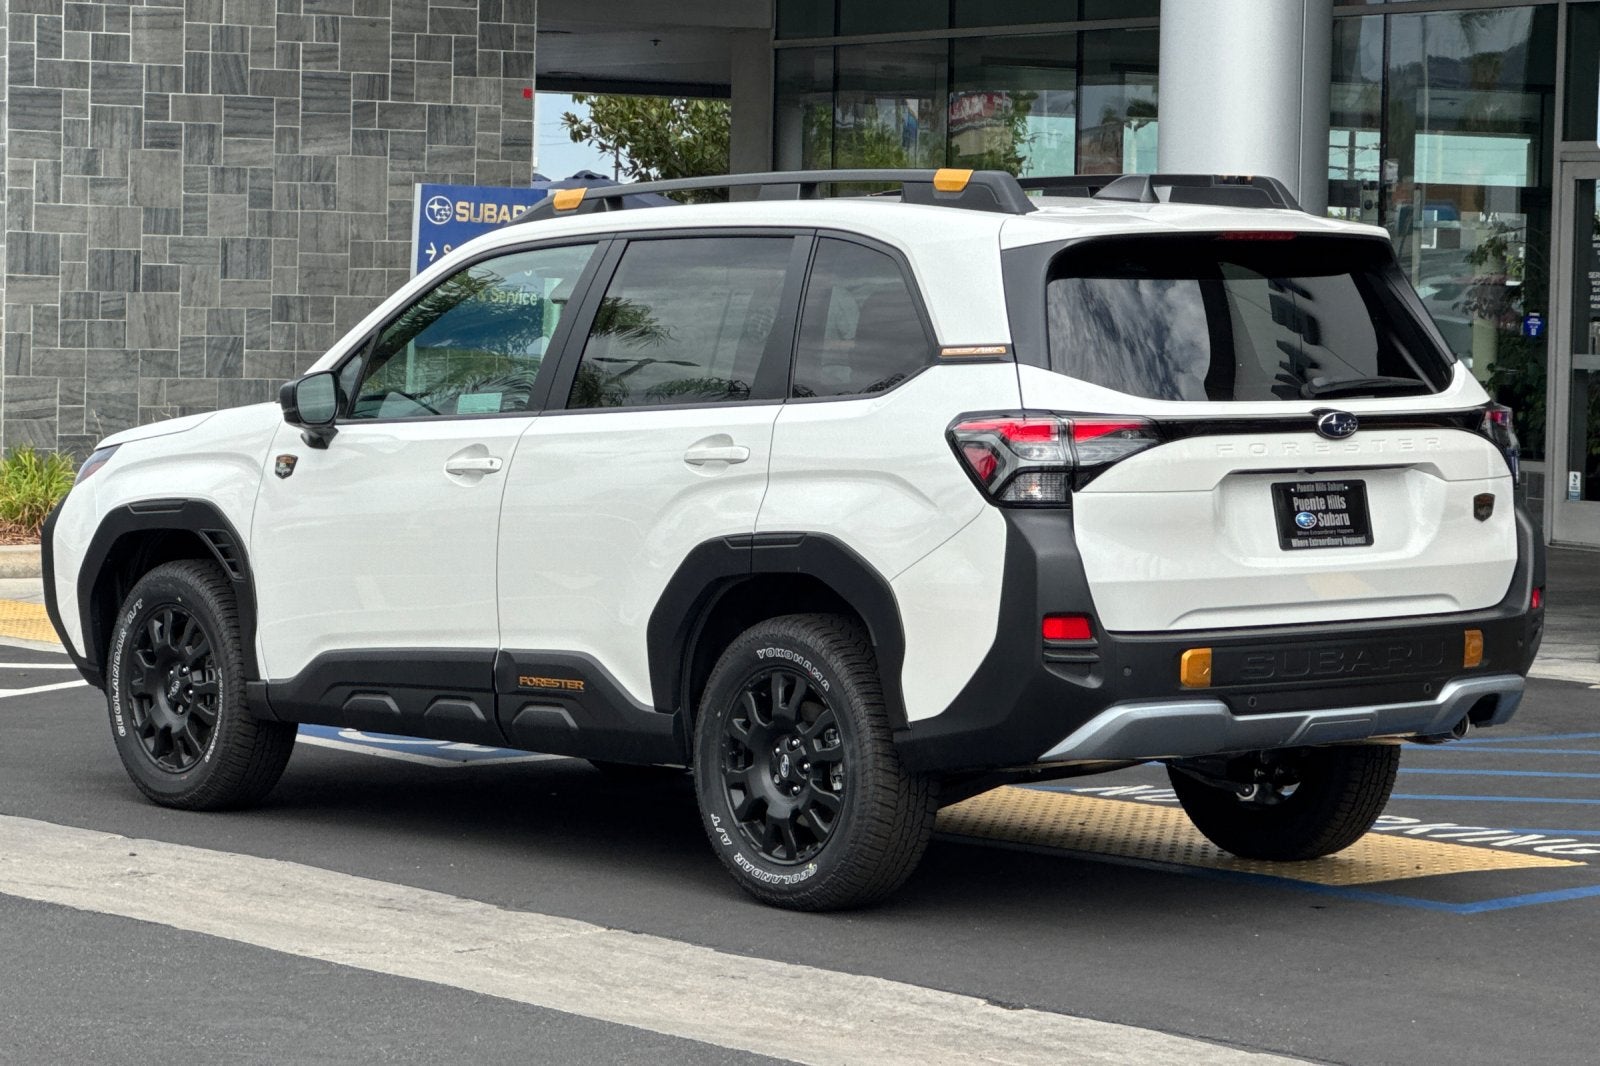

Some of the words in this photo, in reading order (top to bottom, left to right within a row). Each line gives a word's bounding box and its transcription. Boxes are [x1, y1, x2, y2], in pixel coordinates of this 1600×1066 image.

[455, 201, 532, 224] SUBAR
[491, 286, 538, 306] Service
[1216, 437, 1441, 457] FORESTER
[1293, 496, 1326, 512] Puente
[1327, 494, 1347, 510] Hills
[1317, 512, 1351, 527] Subaru
[757, 647, 830, 692] YOKOHAMA
[1241, 641, 1446, 680] SUBARU
[519, 676, 585, 691] FORESTER
[711, 813, 732, 846] A/T
[734, 852, 817, 884] GEOLANDAR
